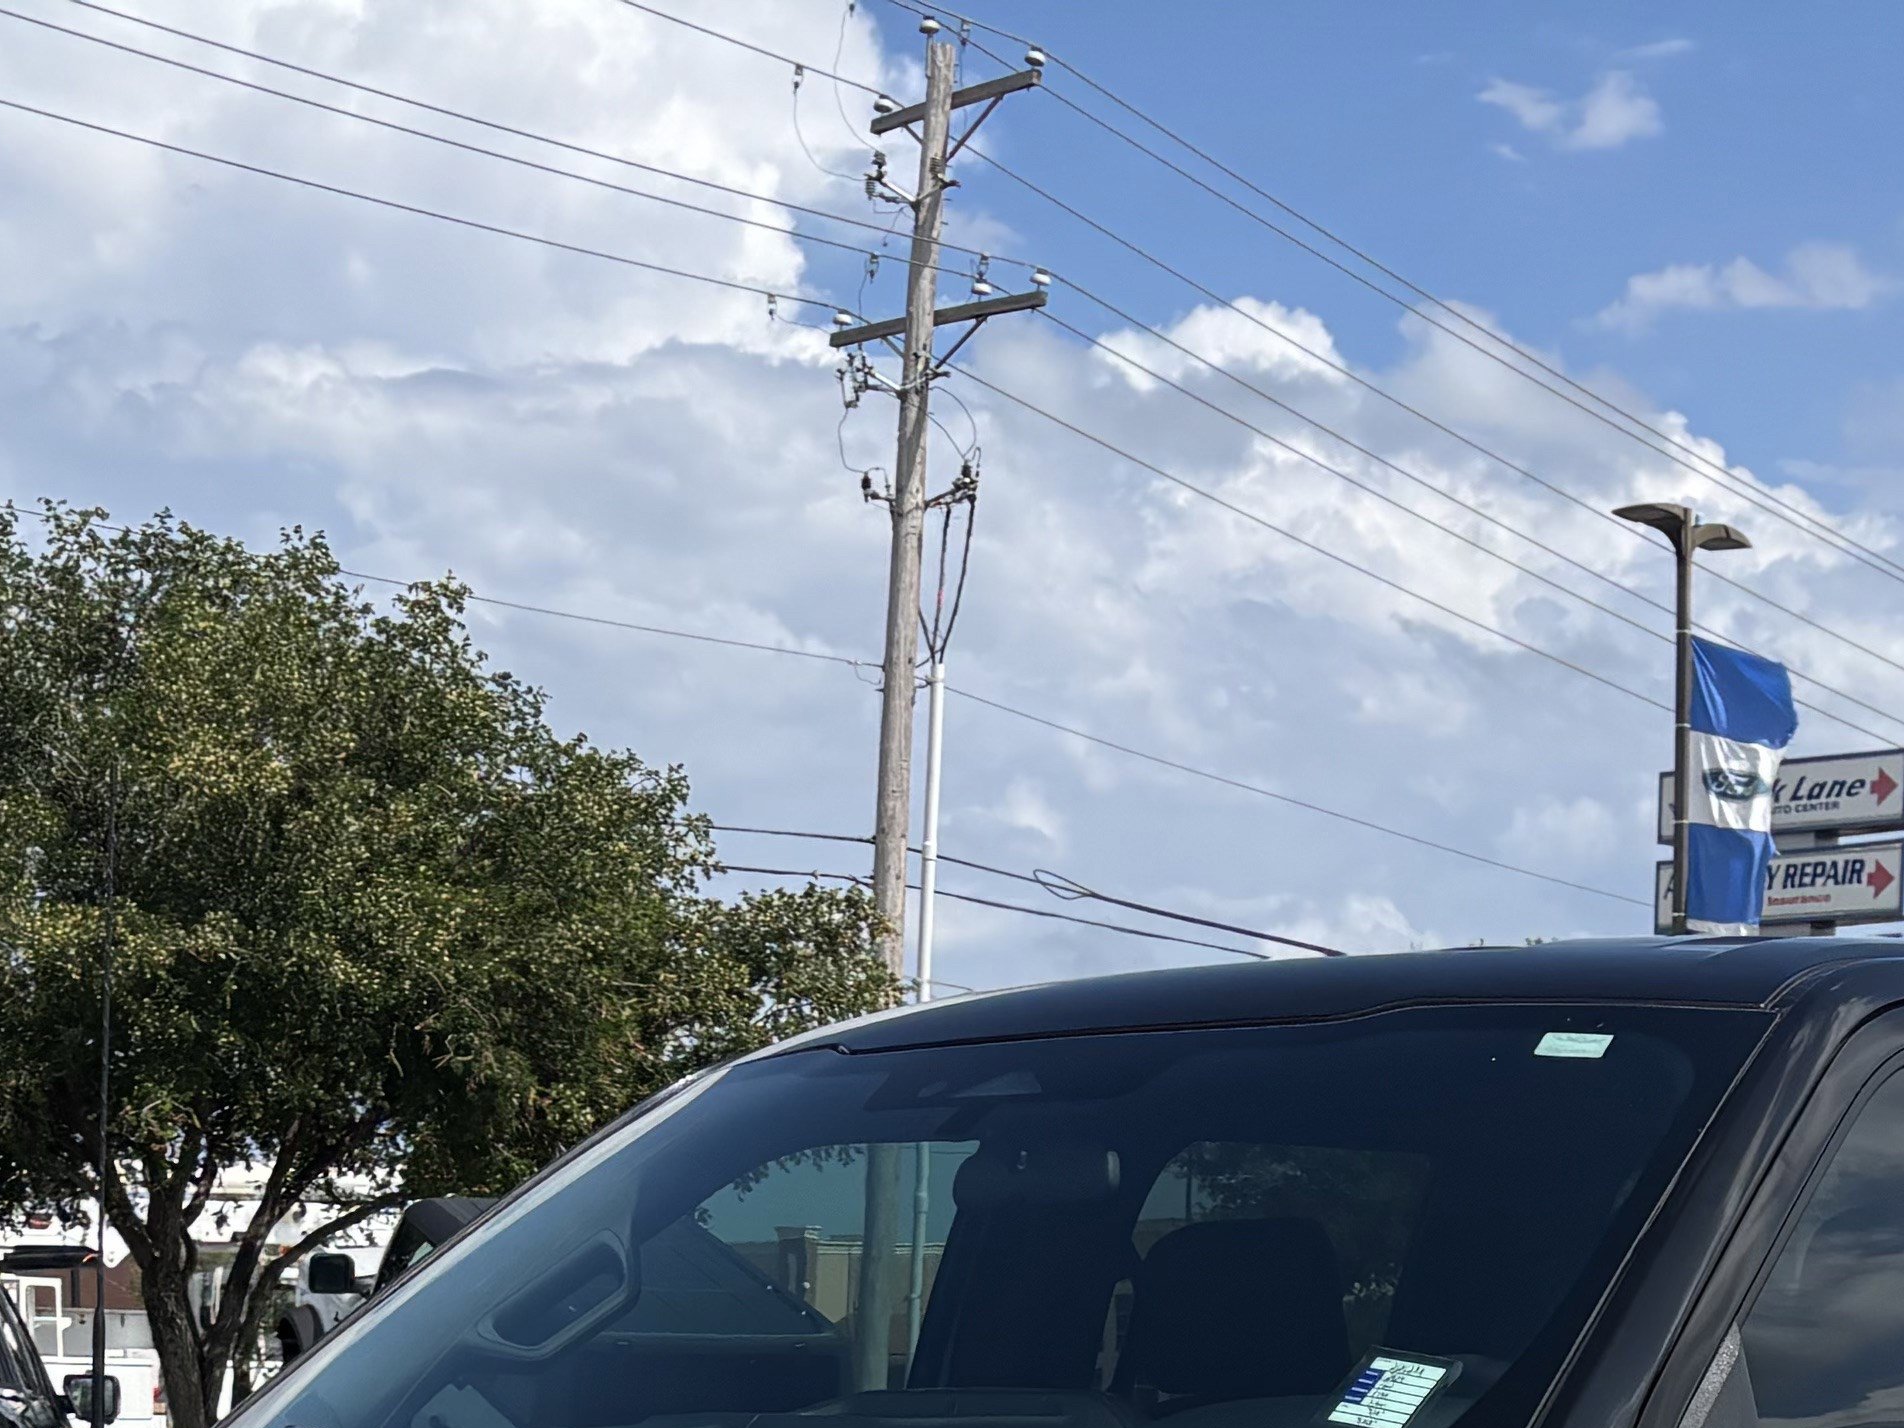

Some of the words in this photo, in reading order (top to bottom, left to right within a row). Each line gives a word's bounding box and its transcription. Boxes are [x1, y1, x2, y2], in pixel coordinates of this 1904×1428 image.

[1790, 775, 1866, 802] Lane
[1794, 801, 1840, 814] CENTER
[1782, 859, 1866, 889] REPAIR
